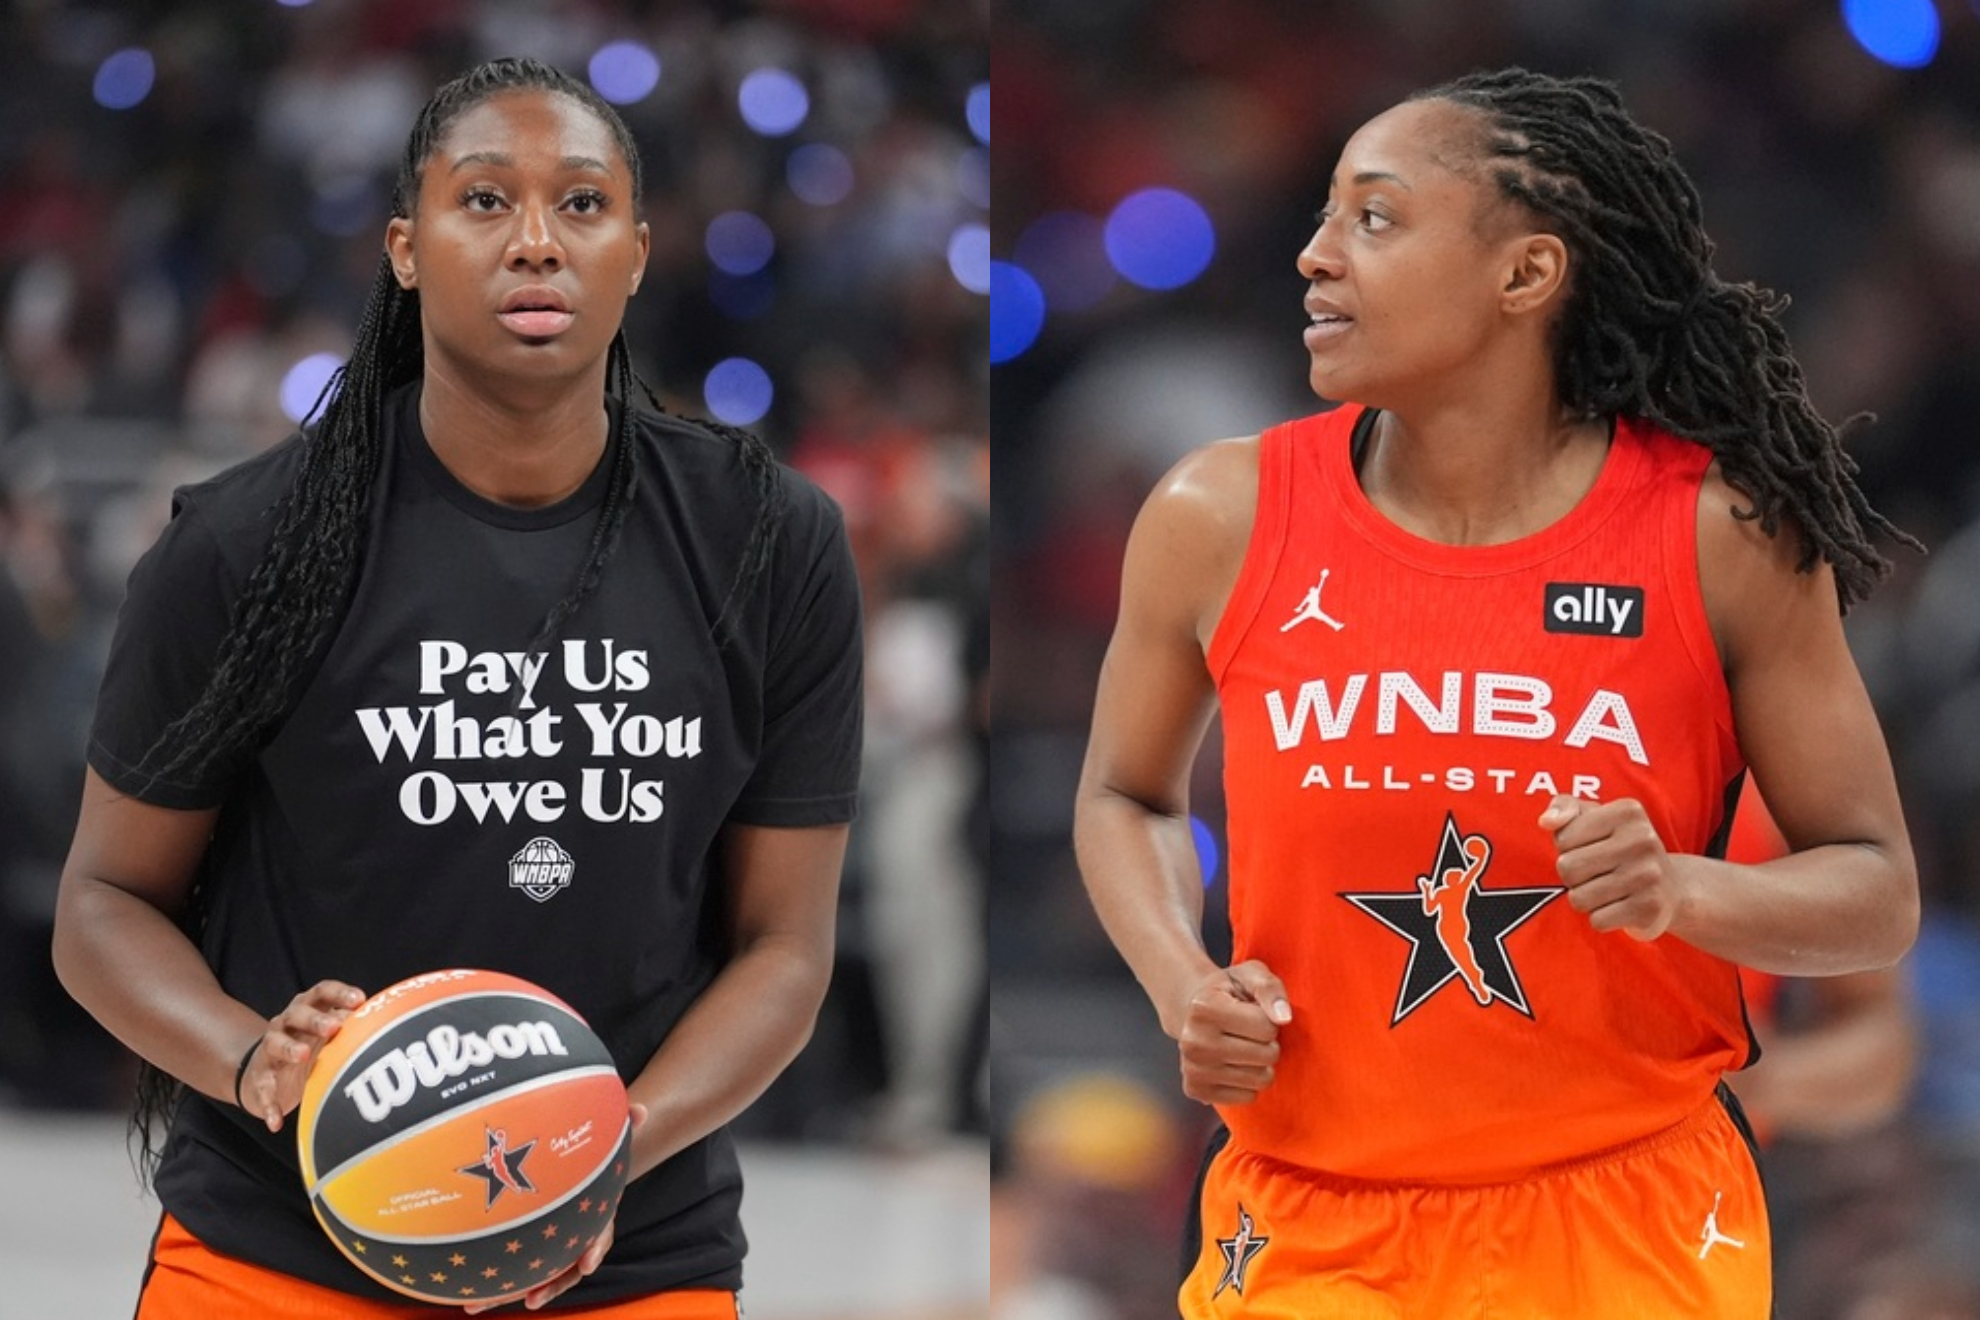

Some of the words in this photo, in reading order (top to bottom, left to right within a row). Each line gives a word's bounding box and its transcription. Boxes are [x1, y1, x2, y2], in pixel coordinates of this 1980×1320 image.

[1553, 587, 1634, 634] ally
[419, 640, 549, 710] Pay
[562, 638, 651, 692] Us
[354, 699, 564, 764] What
[573, 702, 703, 760] You
[1264, 670, 1650, 766] WNBA
[399, 770, 566, 825] Owe
[580, 767, 665, 823] Us
[1300, 764, 1602, 800] ALL-STAR
[513, 863, 571, 885] WNBPA
[344, 1020, 570, 1122] Wilson
[441, 1081, 468, 1099] EVO
[470, 1070, 496, 1086] NXT
